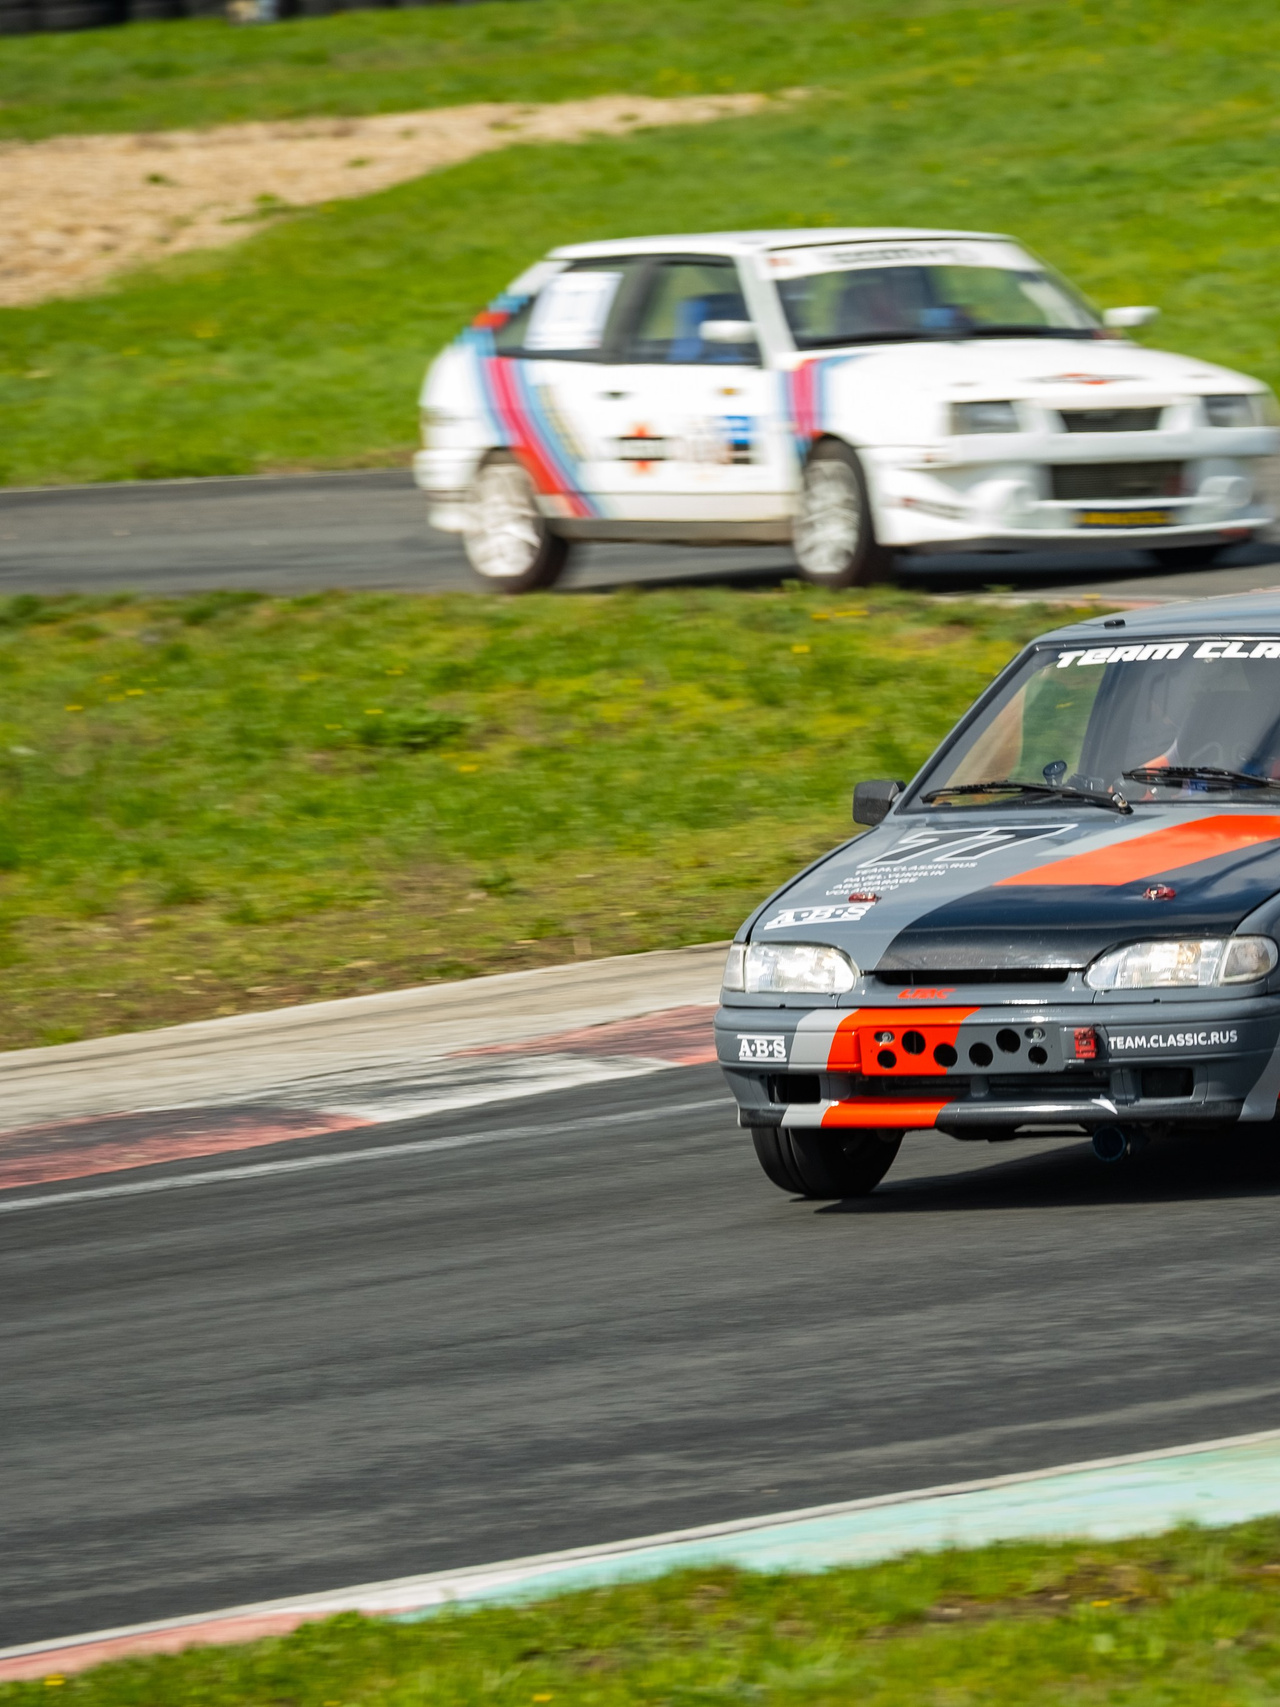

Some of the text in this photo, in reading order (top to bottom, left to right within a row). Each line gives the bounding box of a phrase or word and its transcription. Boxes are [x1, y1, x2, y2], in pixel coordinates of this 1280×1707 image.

[1055, 642, 1190, 669] TEAM
[857, 823, 1079, 869] 77
[1108, 1029, 1238, 1051] TEAM.CLASSIC.RUS
